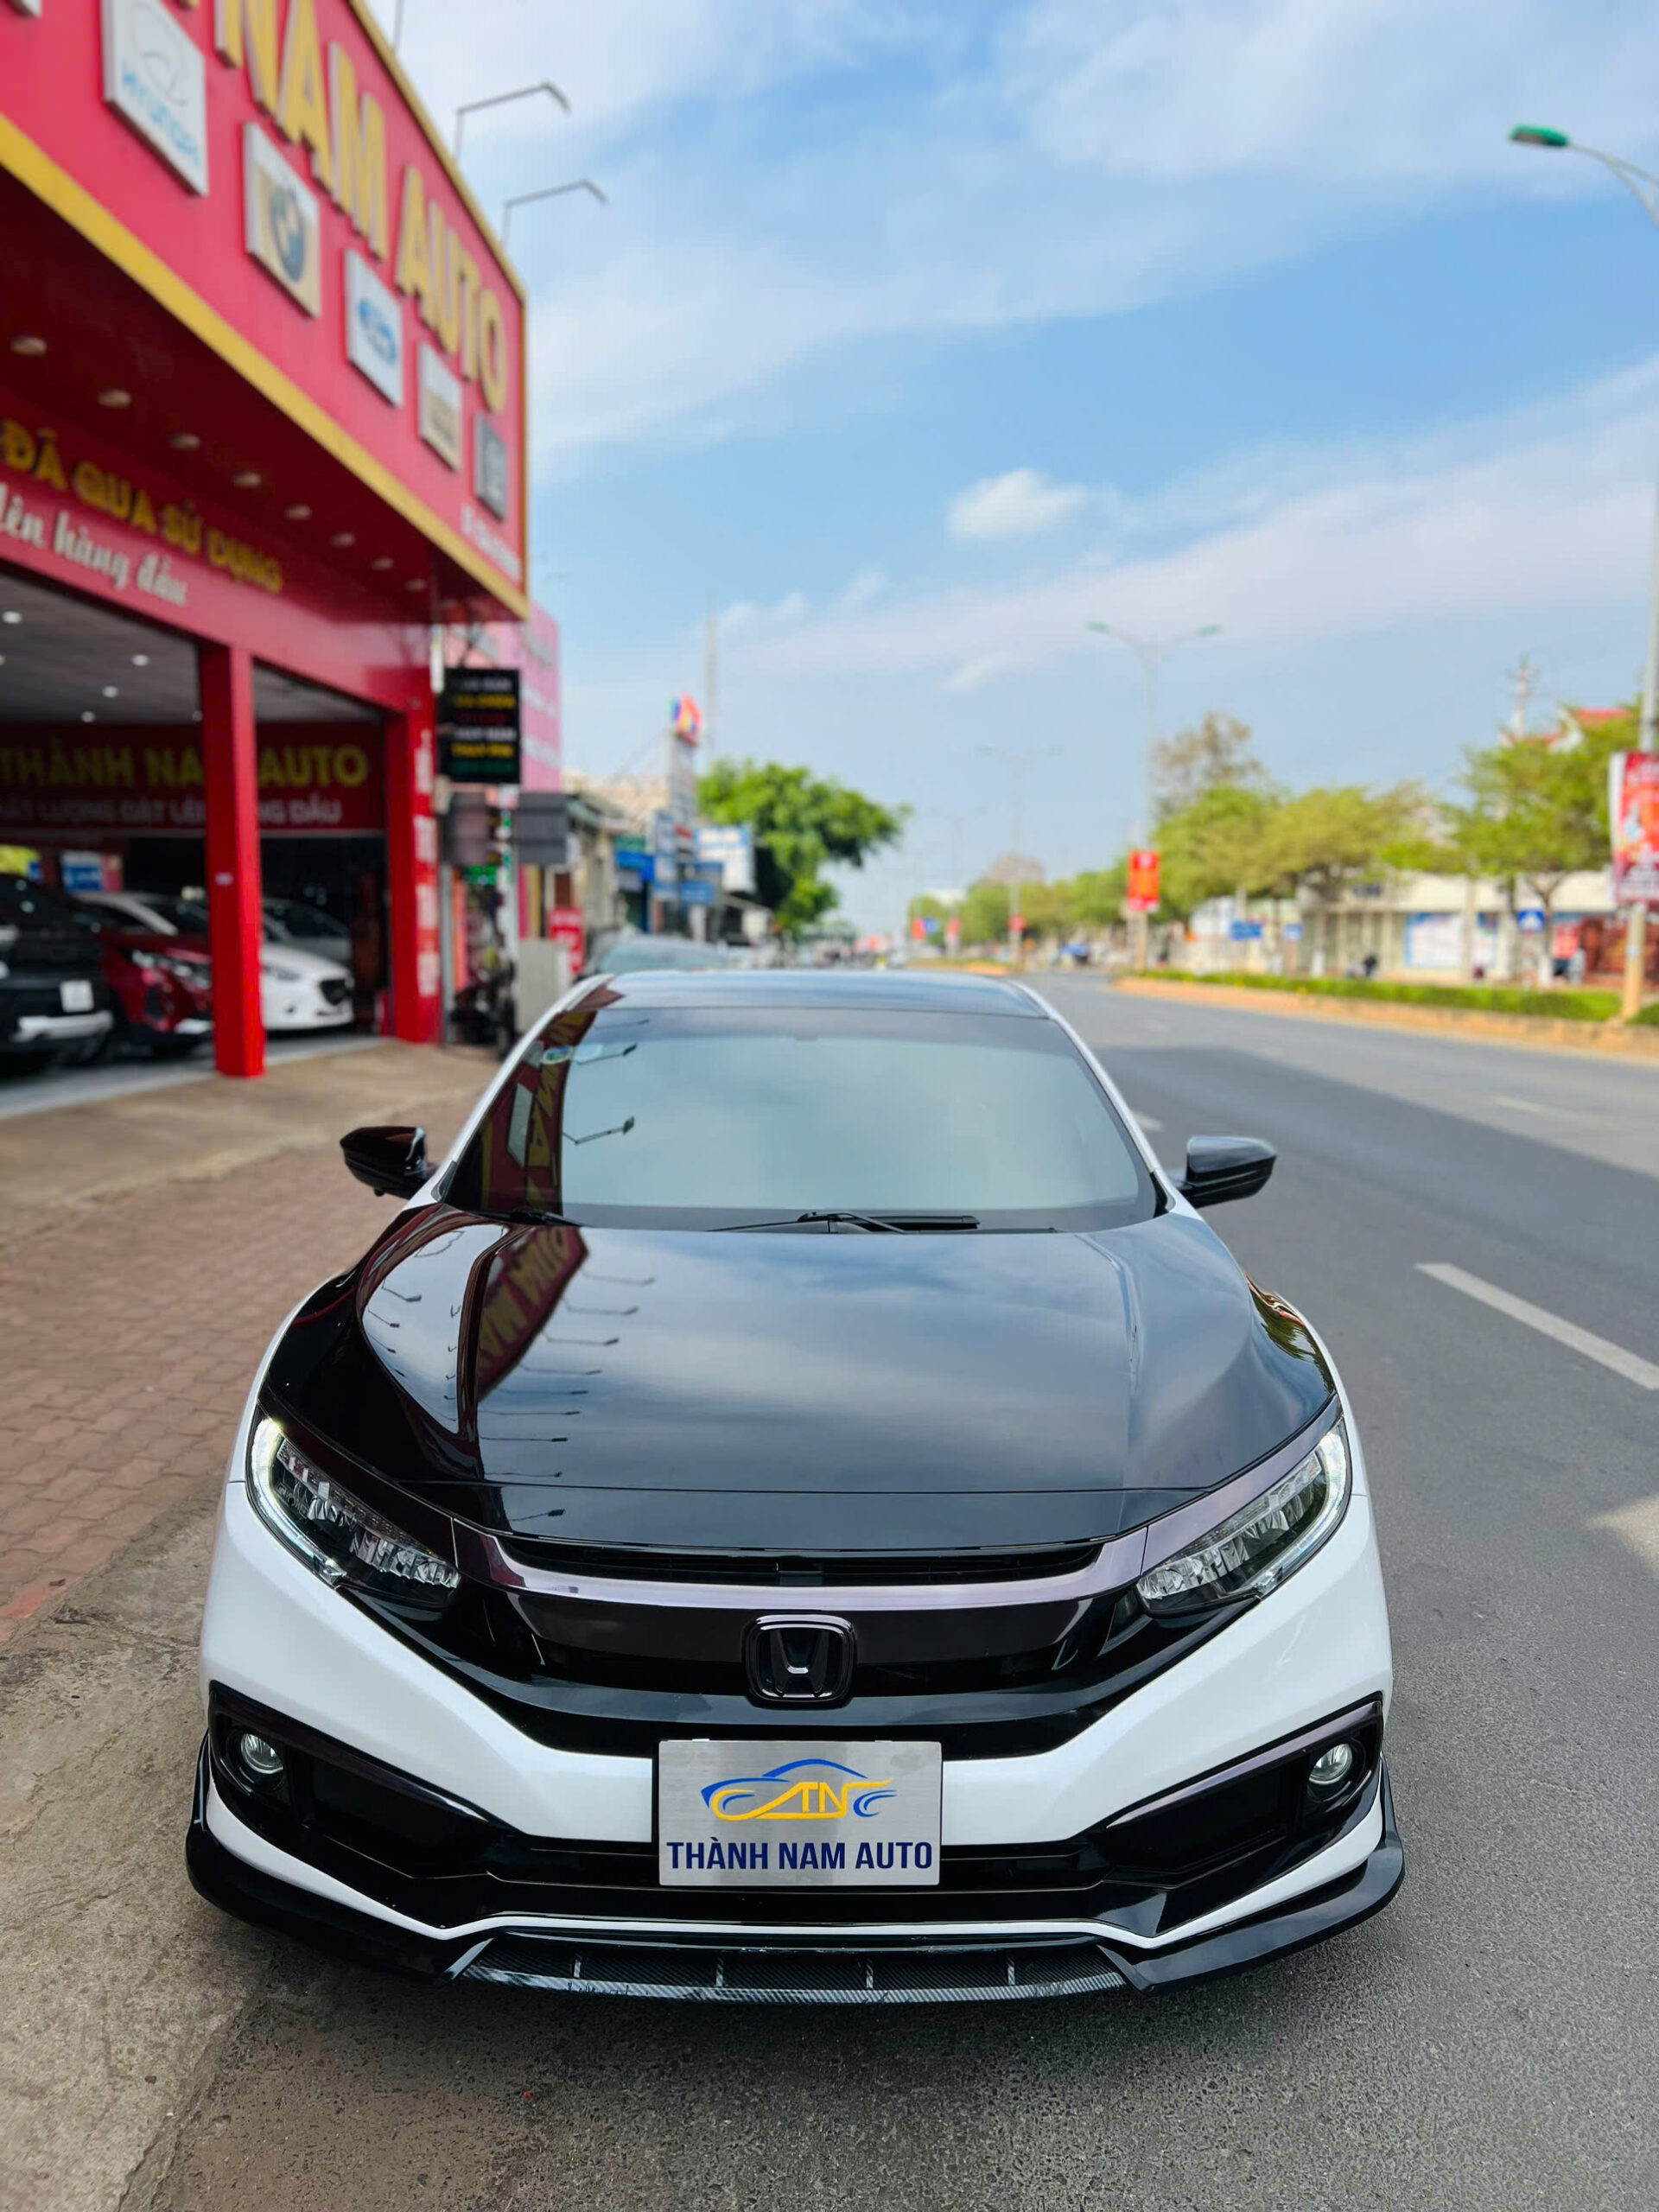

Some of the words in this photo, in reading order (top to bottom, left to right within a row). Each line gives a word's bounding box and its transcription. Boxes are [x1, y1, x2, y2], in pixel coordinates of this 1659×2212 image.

[395, 164, 508, 416] AUTO
[73, 460, 158, 537] QUA
[53, 510, 130, 591] hàng
[144, 745, 205, 789] NA
[258, 744, 371, 789] AUTO
[666, 1836, 768, 1870] THÀNH
[779, 1841, 846, 1870] NAM
[855, 1841, 932, 1870] AUTO
